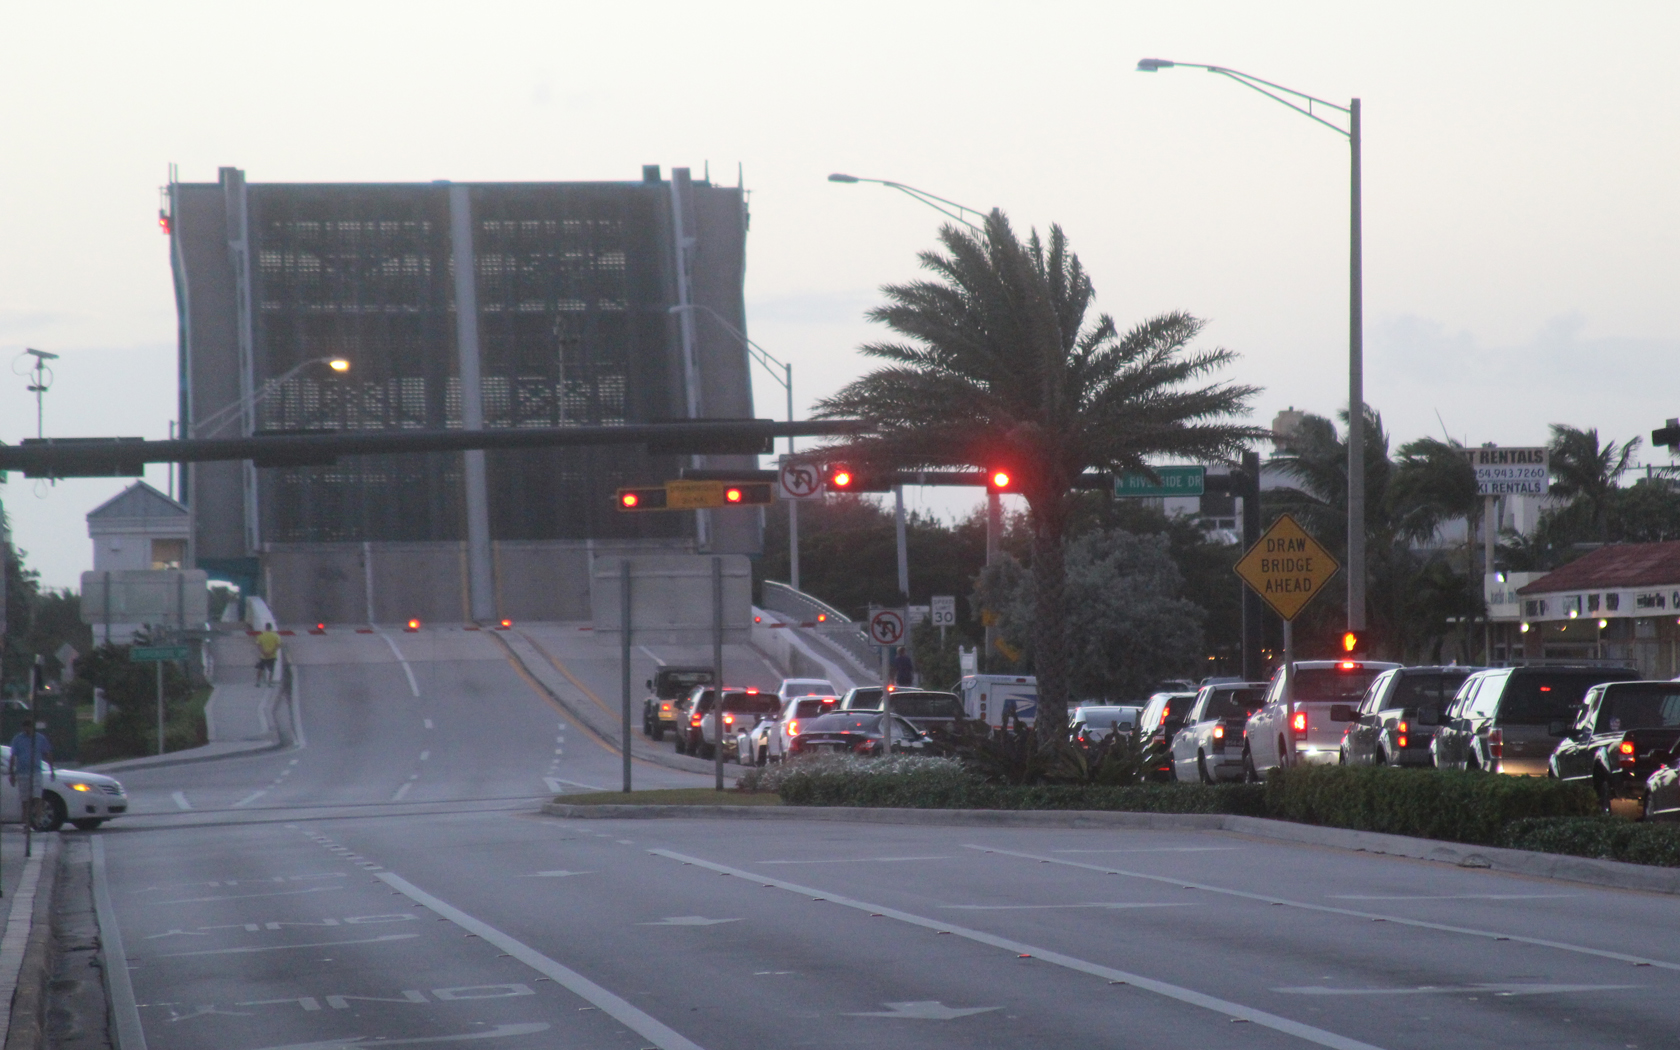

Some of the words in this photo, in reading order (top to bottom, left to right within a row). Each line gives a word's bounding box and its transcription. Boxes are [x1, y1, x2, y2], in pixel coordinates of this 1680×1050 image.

[1480, 450, 1544, 464] RENTALS
[1474, 468, 1545, 478] 54.943.7260
[1116, 477, 1123, 488] N
[1188, 475, 1202, 487] DR
[1492, 482, 1541, 493] RENTALS
[1267, 537, 1306, 552] DRAW
[1261, 558, 1313, 573] BRIDGE
[1265, 578, 1311, 593] AHEAD
[935, 611, 953, 623] 30
